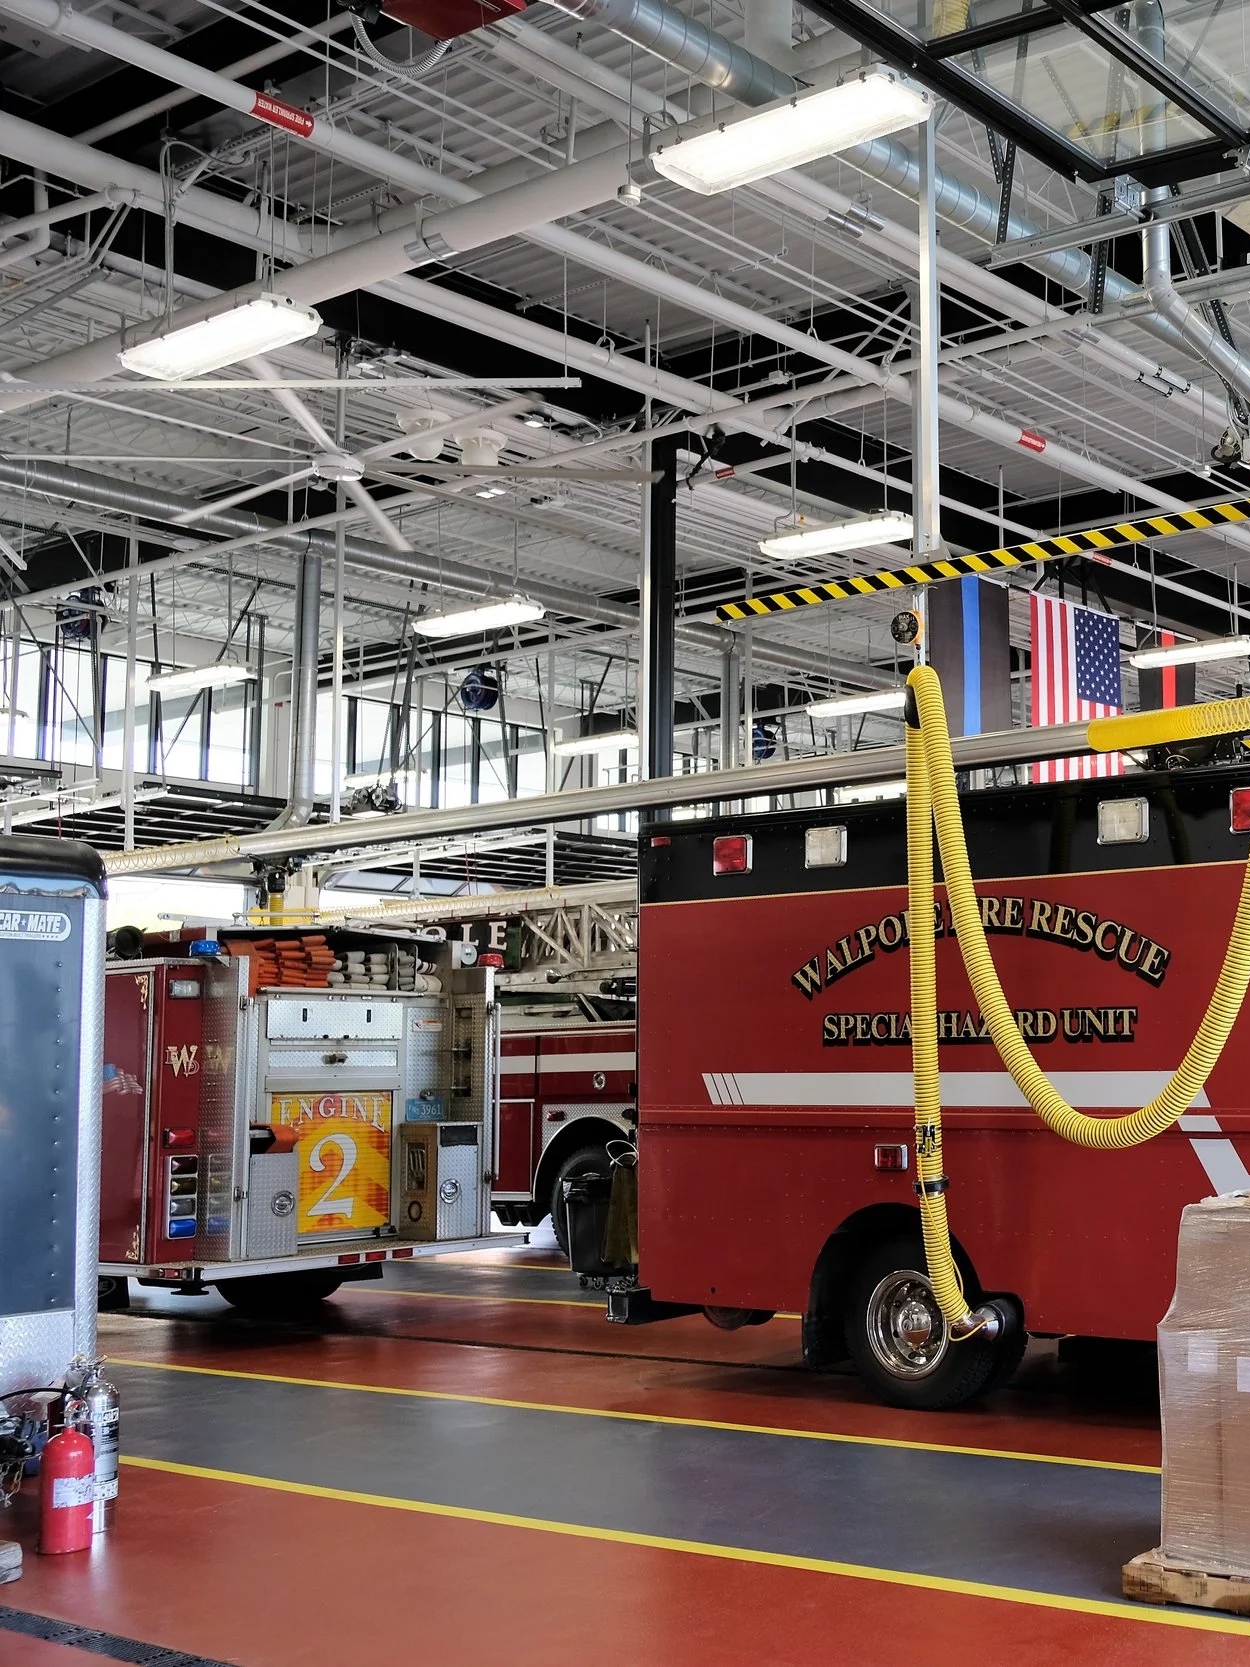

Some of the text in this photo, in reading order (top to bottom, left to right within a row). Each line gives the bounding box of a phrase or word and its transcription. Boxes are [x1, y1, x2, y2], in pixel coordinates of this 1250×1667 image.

[294, 114, 305, 126] FIRE
[27, 914, 61, 932] MATE
[949, 897, 1023, 930] RE
[1029, 900, 1170, 980] RESCUE
[823, 1008, 1137, 1040] SPECIA HAZRD UNIT
[279, 1096, 386, 1133] ENGINE
[420, 1103, 443, 1117] 3961
[307, 1133, 358, 1219] 2
